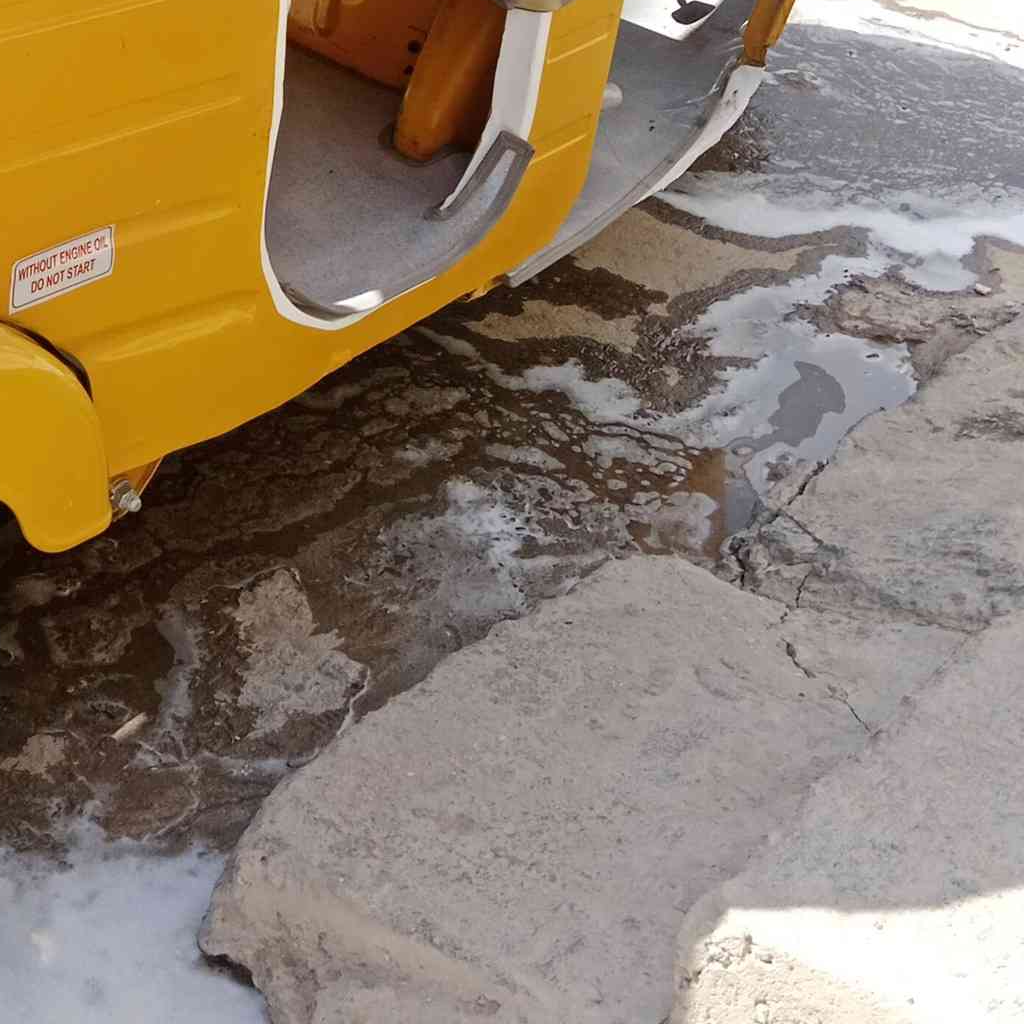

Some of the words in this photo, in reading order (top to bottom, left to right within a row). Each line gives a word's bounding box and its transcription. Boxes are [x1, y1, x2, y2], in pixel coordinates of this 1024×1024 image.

[18, 253, 58, 281] WITHOUT
[59, 240, 92, 265] ENGINE
[93, 235, 108, 251] OIL
[30, 278, 44, 293] DO
[46, 270, 64, 288] NOT
[67, 258, 96, 279] START
